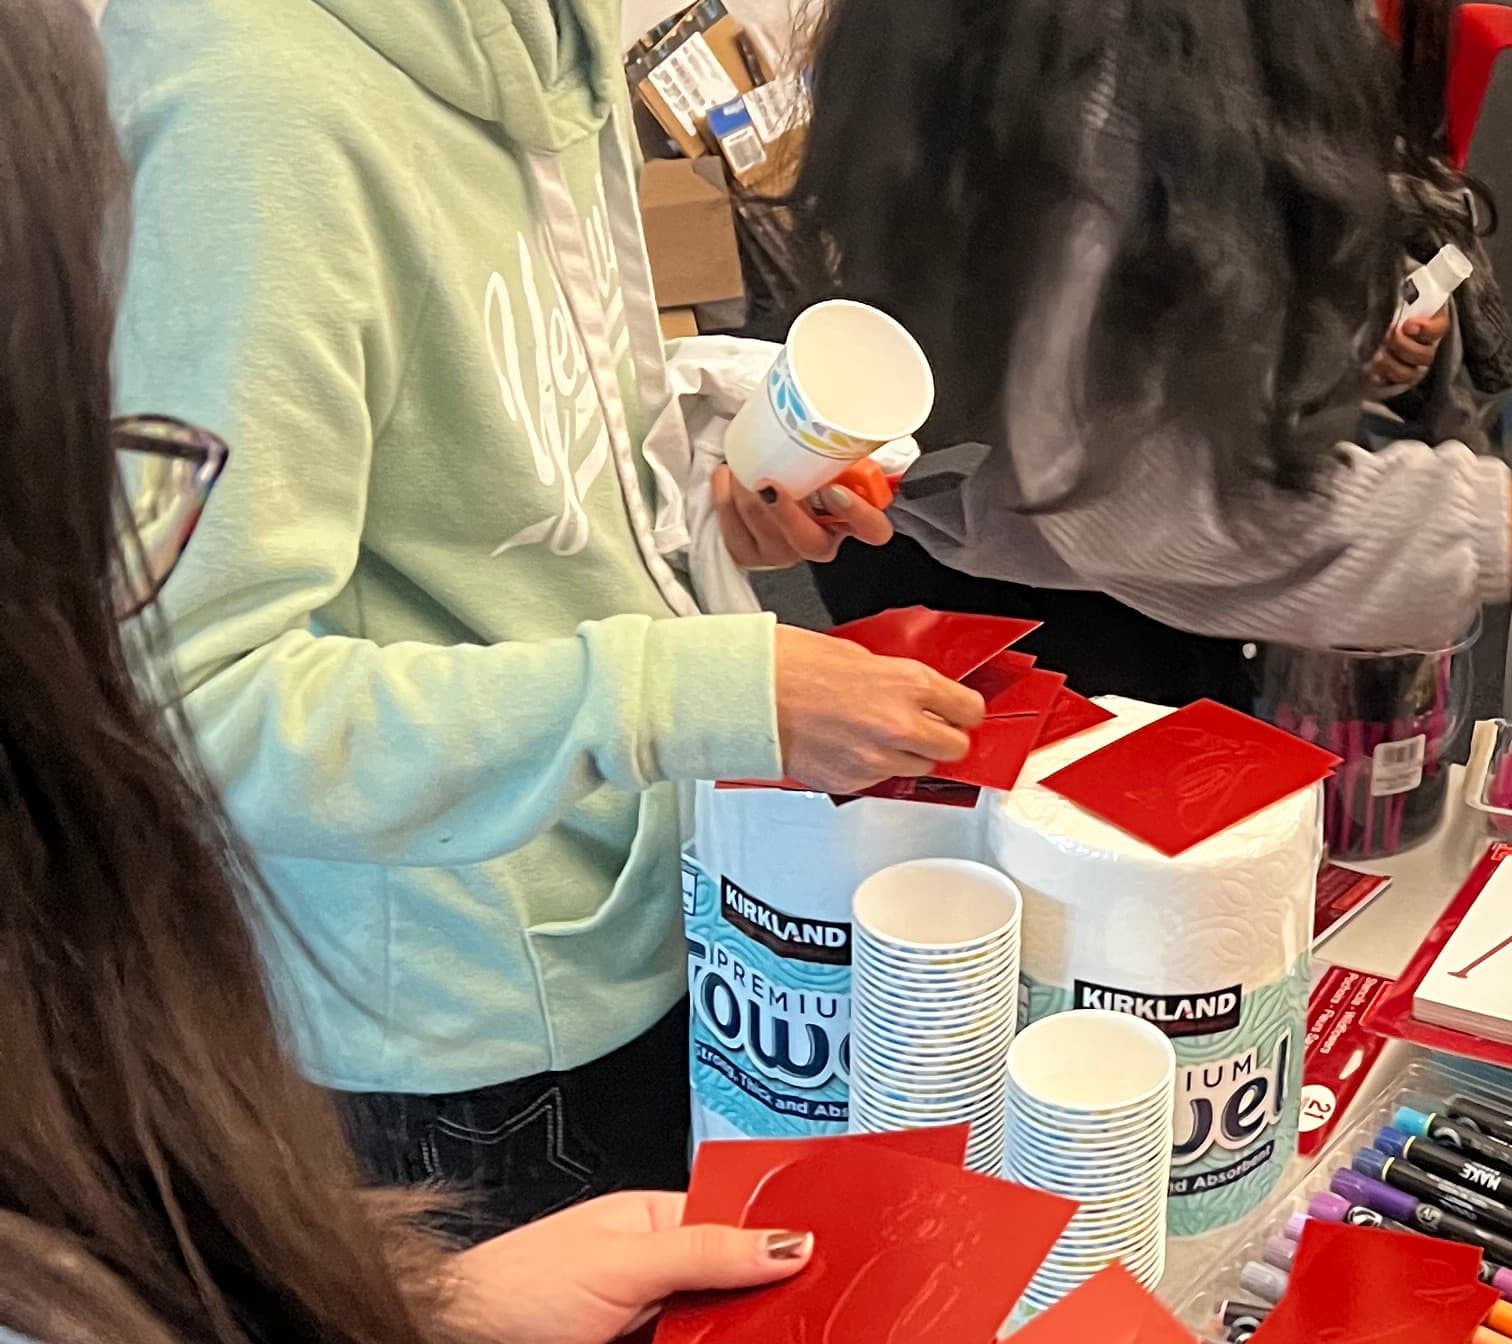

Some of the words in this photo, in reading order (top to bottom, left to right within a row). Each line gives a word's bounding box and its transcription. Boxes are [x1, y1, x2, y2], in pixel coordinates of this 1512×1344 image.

[724, 884, 848, 949] KIRKLAND
[717, 948, 851, 1019] PREMIU
[1082, 987, 1236, 1022] KIRKLAND
[774, 1097, 809, 1114] and
[1304, 1098, 1331, 1121] 21
[1192, 1144, 1271, 1190] Absorbent
[1458, 1162, 1502, 1191] MAKE
